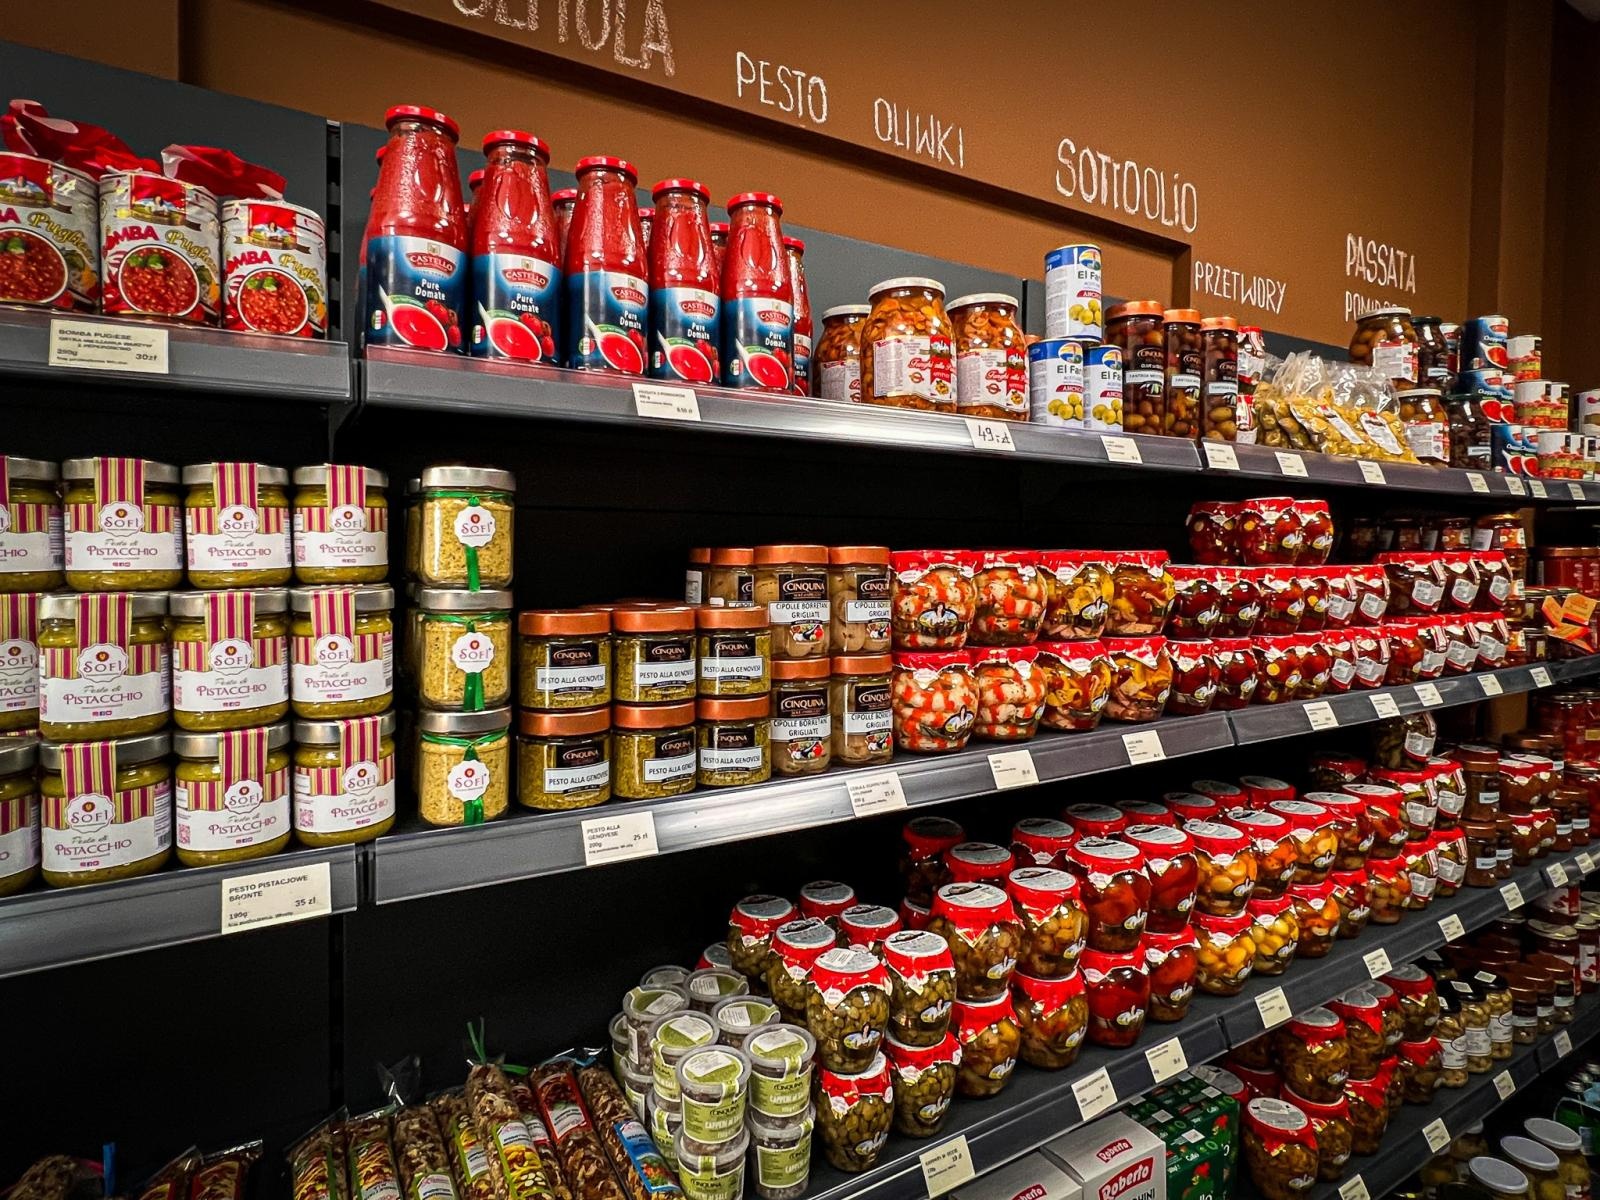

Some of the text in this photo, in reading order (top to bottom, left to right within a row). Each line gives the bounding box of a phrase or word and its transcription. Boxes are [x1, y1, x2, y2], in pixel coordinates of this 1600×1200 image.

[736, 51, 828, 125] PESTO
[874, 98, 964, 168] OLIWKI
[410, 254, 453, 271] CASTELLO
[1345, 232, 1417, 294] PASSATA
[505, 270, 546, 285] CASTELLO
[1077, 270, 1088, 280] El
[421, 278, 440, 291] Pure
[1194, 260, 1287, 315] PRZETWORY
[415, 286, 446, 301] Domate
[516, 292, 534, 304] Pure
[510, 300, 540, 313] Domate
[1056, 364, 1067, 374] El
[1100, 371, 1112, 380] El
[86, 545, 158, 556] PISTACCHIO
[207, 546, 272, 557] PISTACCHIO
[196, 683, 267, 697] PISTACCHIO
[63, 691, 143, 705] PISTACCHIO
[548, 778, 569, 786] PESTO
[208, 815, 277, 835] PISTACCHIO
[54, 839, 132, 856] PISTACCHIO
[229, 875, 308, 894] PESTO PISTACJOWE
[229, 890, 263, 902] BRONTE
[295, 899, 306, 907] 35
[1099, 1140, 1130, 1160] Roberto
[1101, 1164, 1150, 1200] Roberto
